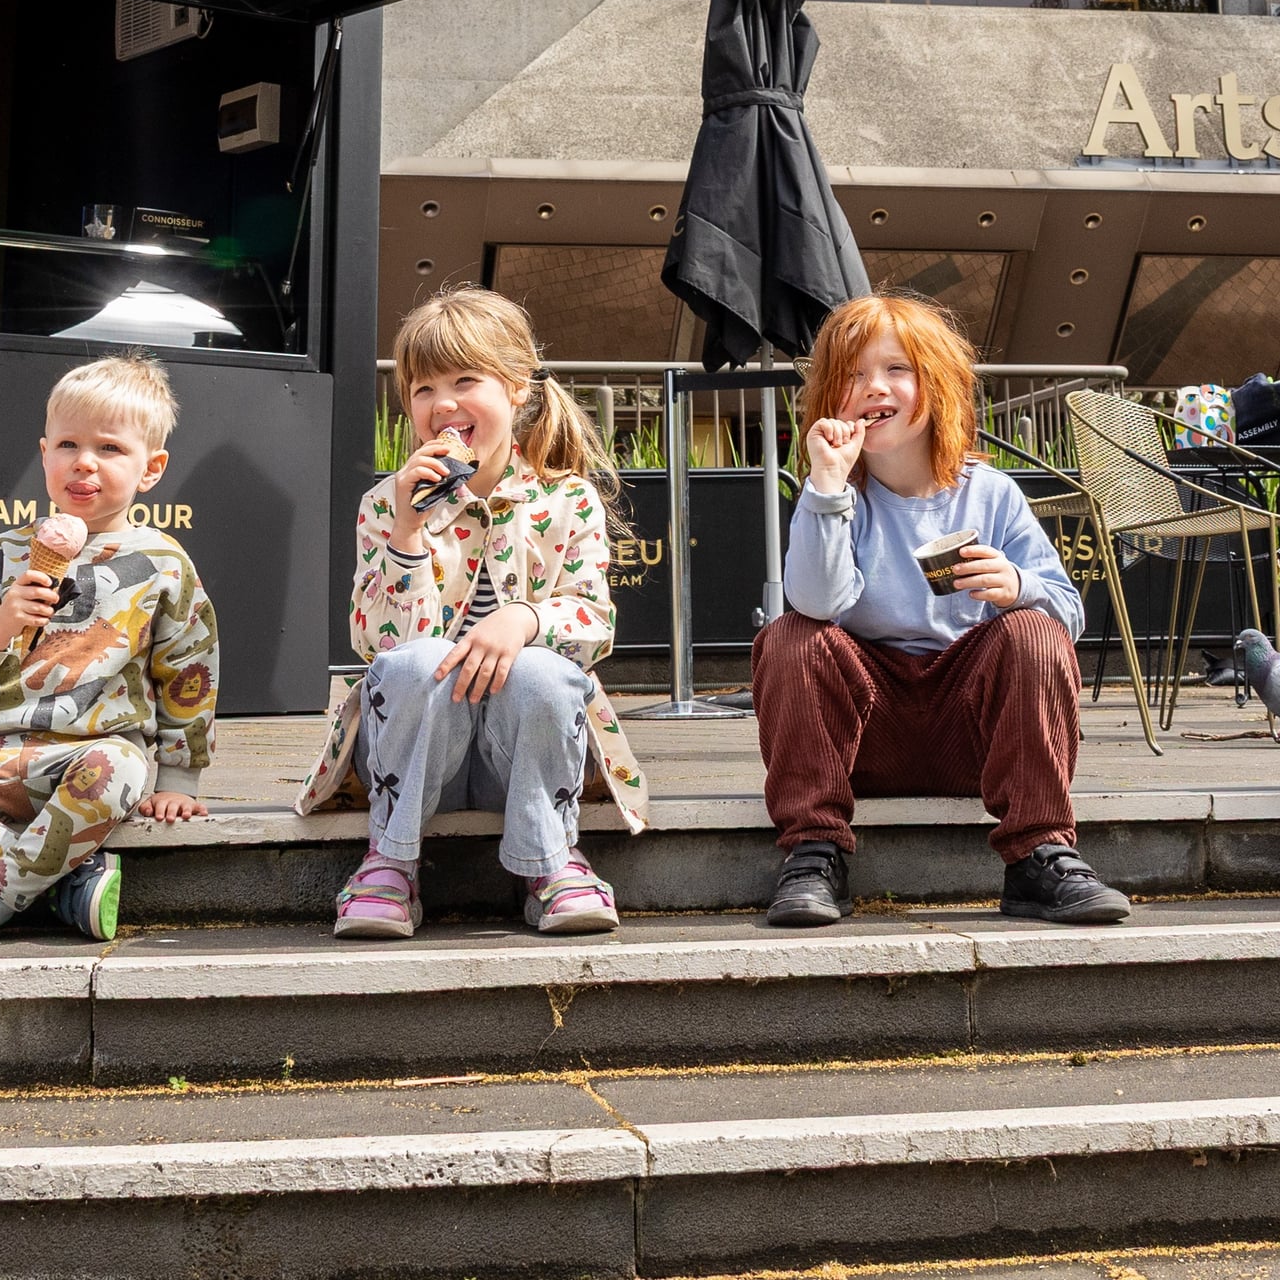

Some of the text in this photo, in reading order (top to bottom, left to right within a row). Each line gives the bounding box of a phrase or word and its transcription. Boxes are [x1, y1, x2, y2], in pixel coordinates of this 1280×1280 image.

[141, 213, 204, 229] CONNOISSEUR
[1238, 418, 1278, 441] ASSEMBLY
[609, 575, 642, 587] EAM
